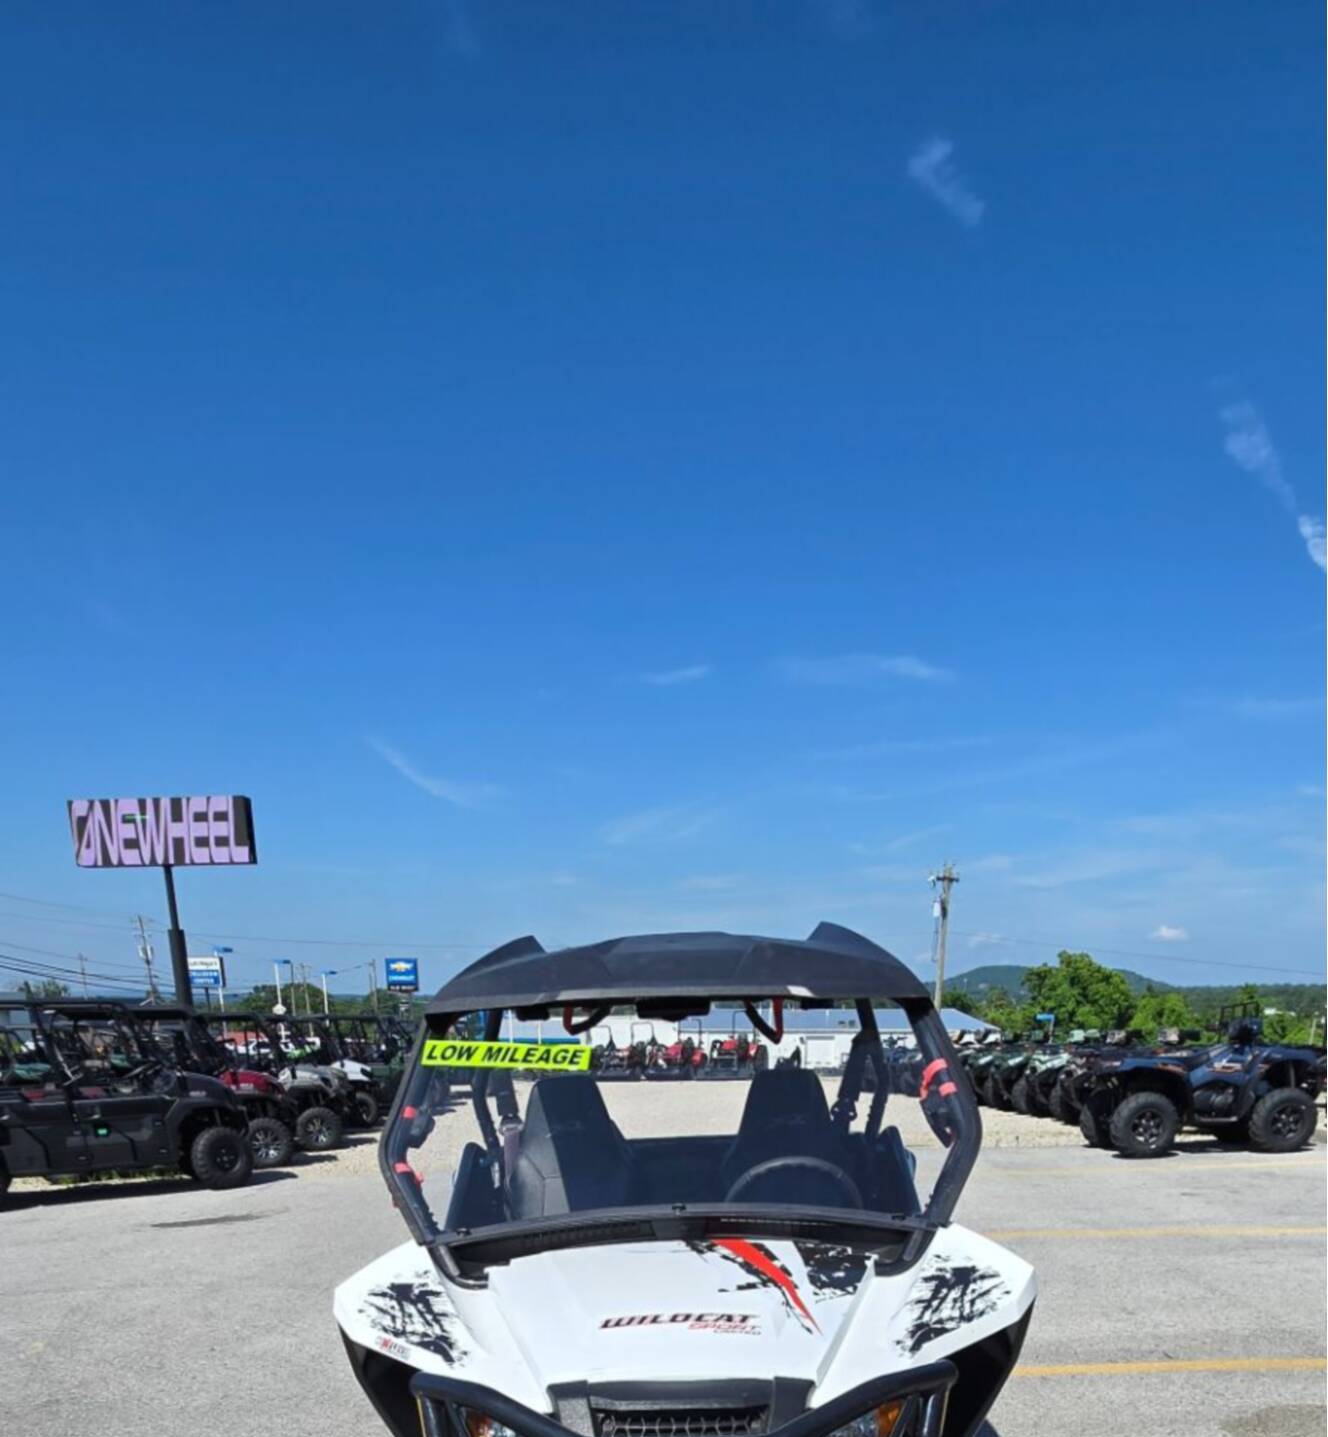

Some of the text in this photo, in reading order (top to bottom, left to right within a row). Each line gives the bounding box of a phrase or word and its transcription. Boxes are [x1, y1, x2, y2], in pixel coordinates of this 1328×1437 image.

[426, 1044, 586, 1066] LOW MILEAGE
[599, 1313, 760, 1330] WILDCAT
[688, 1322, 762, 1331] SPORT
